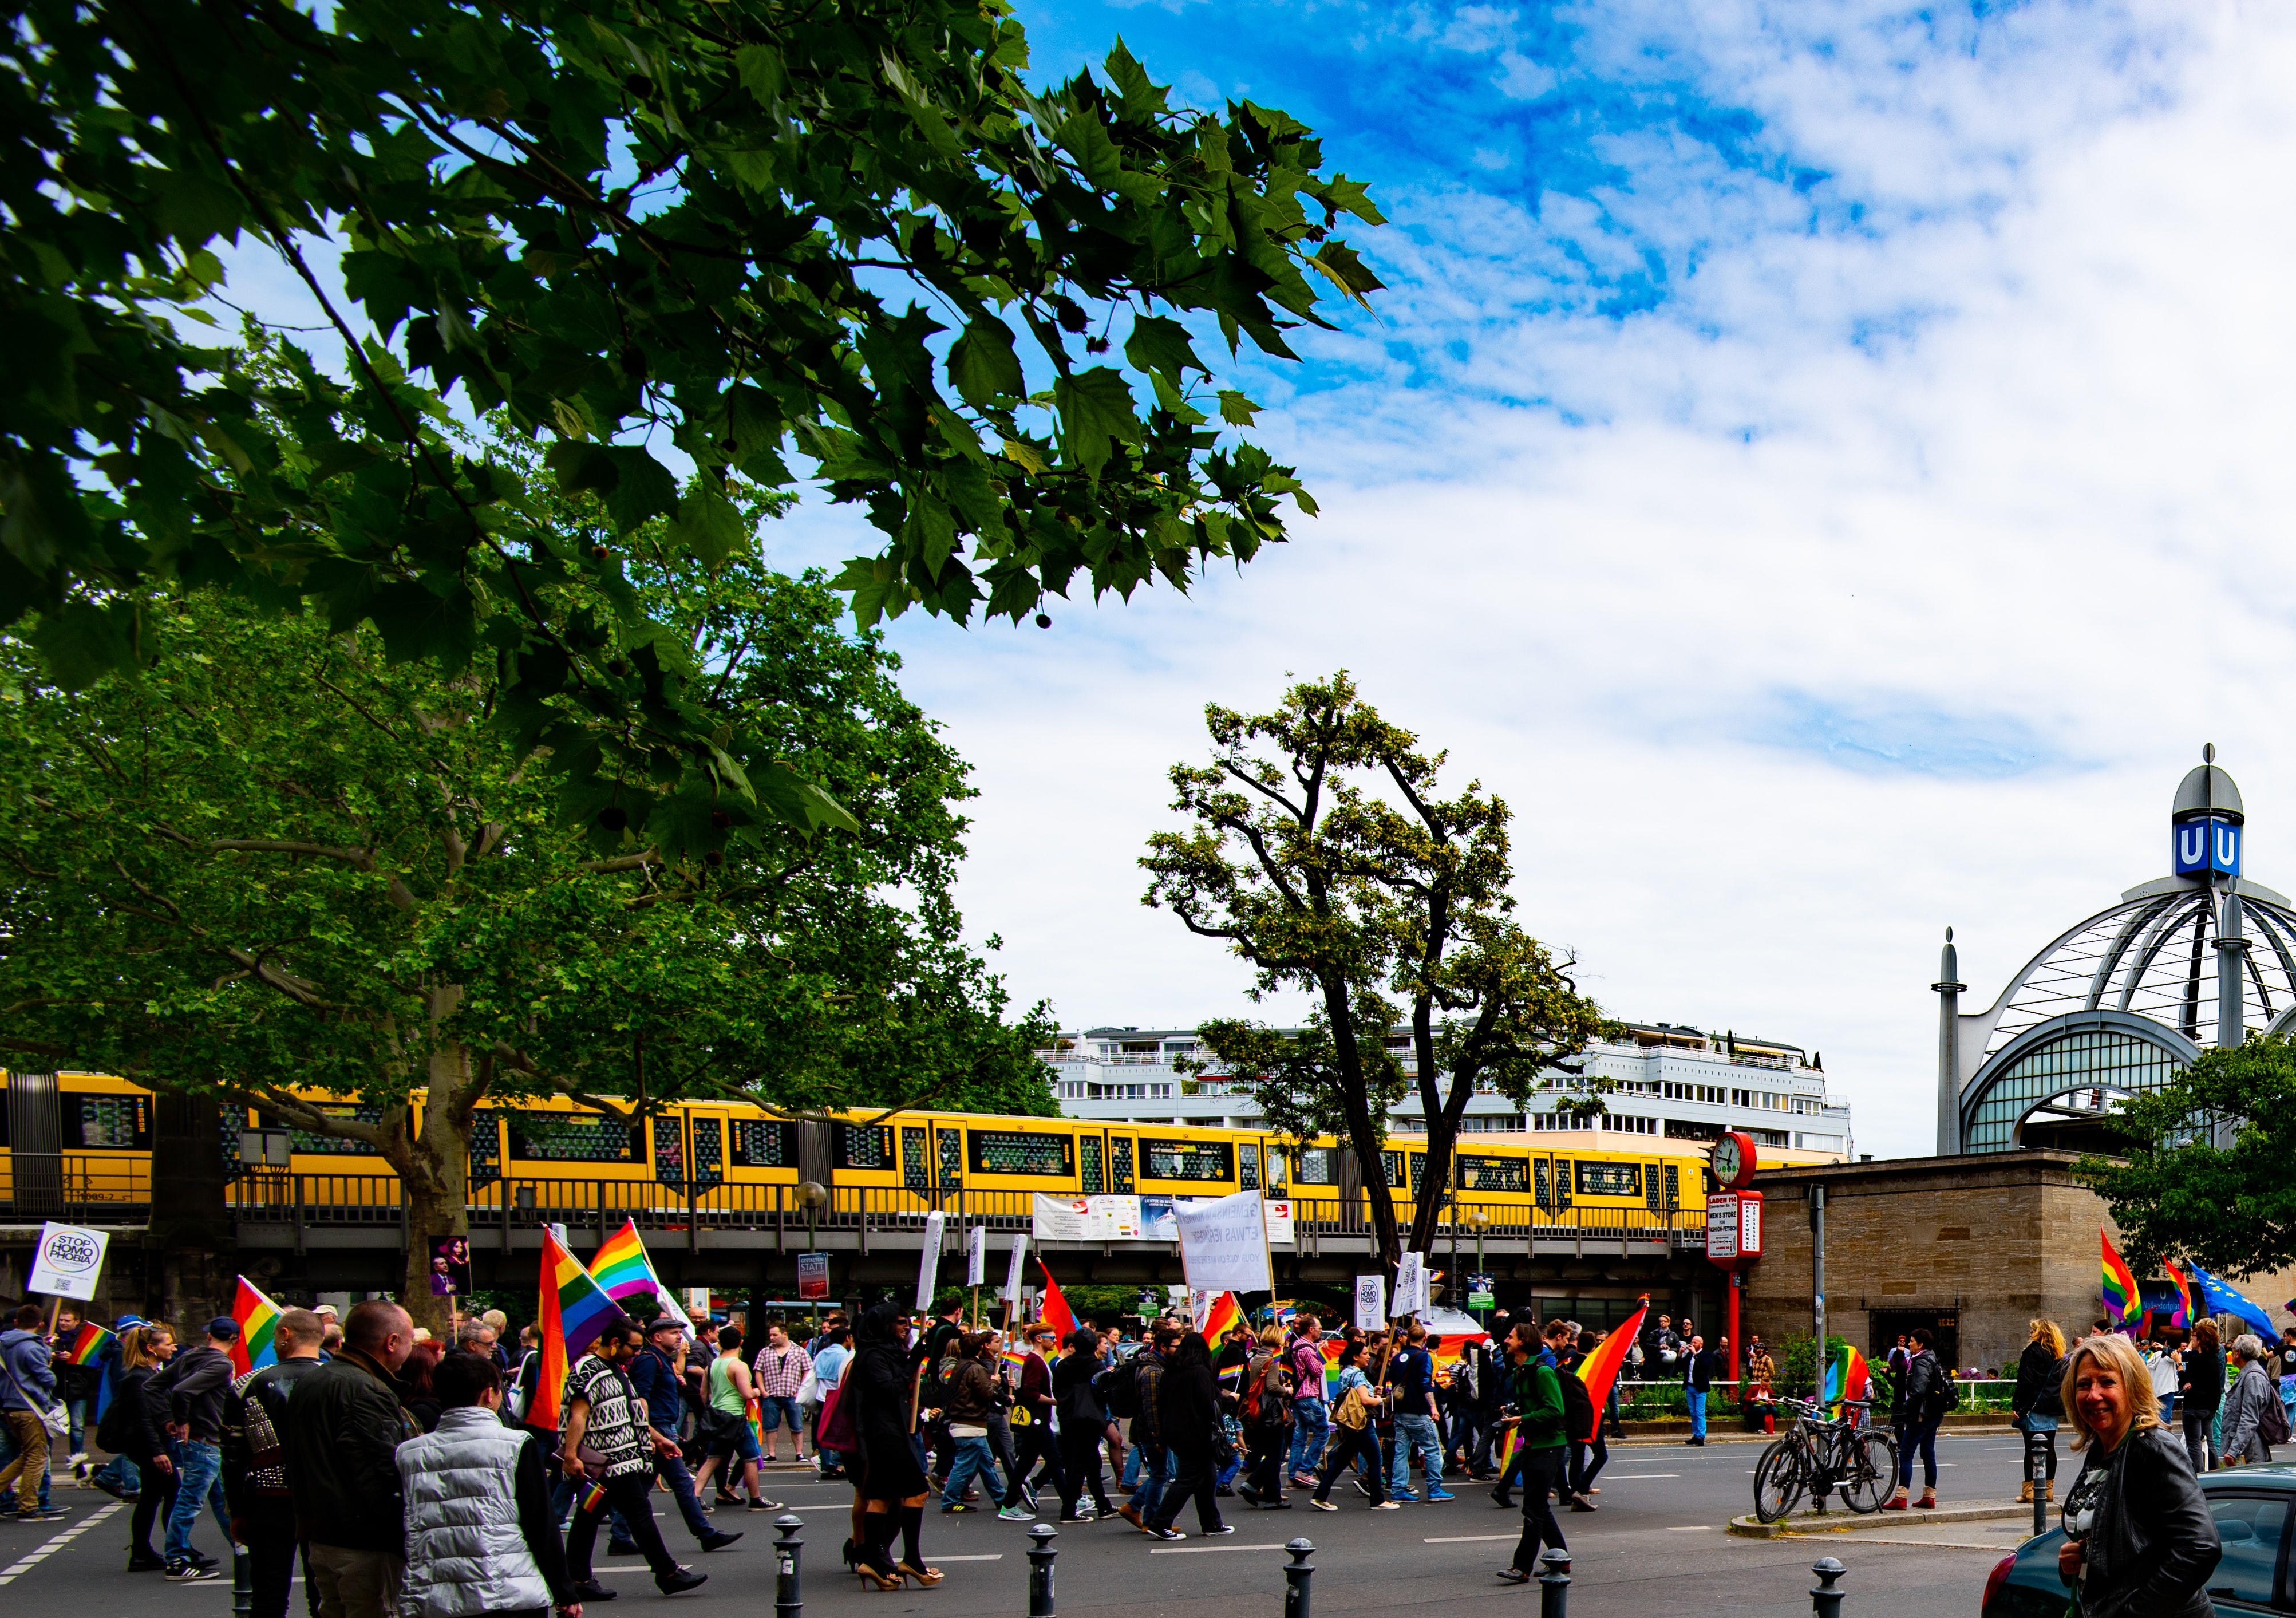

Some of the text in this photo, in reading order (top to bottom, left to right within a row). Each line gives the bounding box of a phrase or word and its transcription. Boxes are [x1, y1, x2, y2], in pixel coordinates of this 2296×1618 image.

[2181, 827, 2203, 865] U
[2217, 827, 2235, 866] U
[58, 1236, 91, 1246] STOP
[52, 1242, 93, 1257] HOMO
[50, 1250, 90, 1264] PHOBIA
[801, 1262, 824, 1271] STATT
[2160, 1288, 2167, 1300] U
[2143, 1301, 2180, 1311] Nollendorfplat
